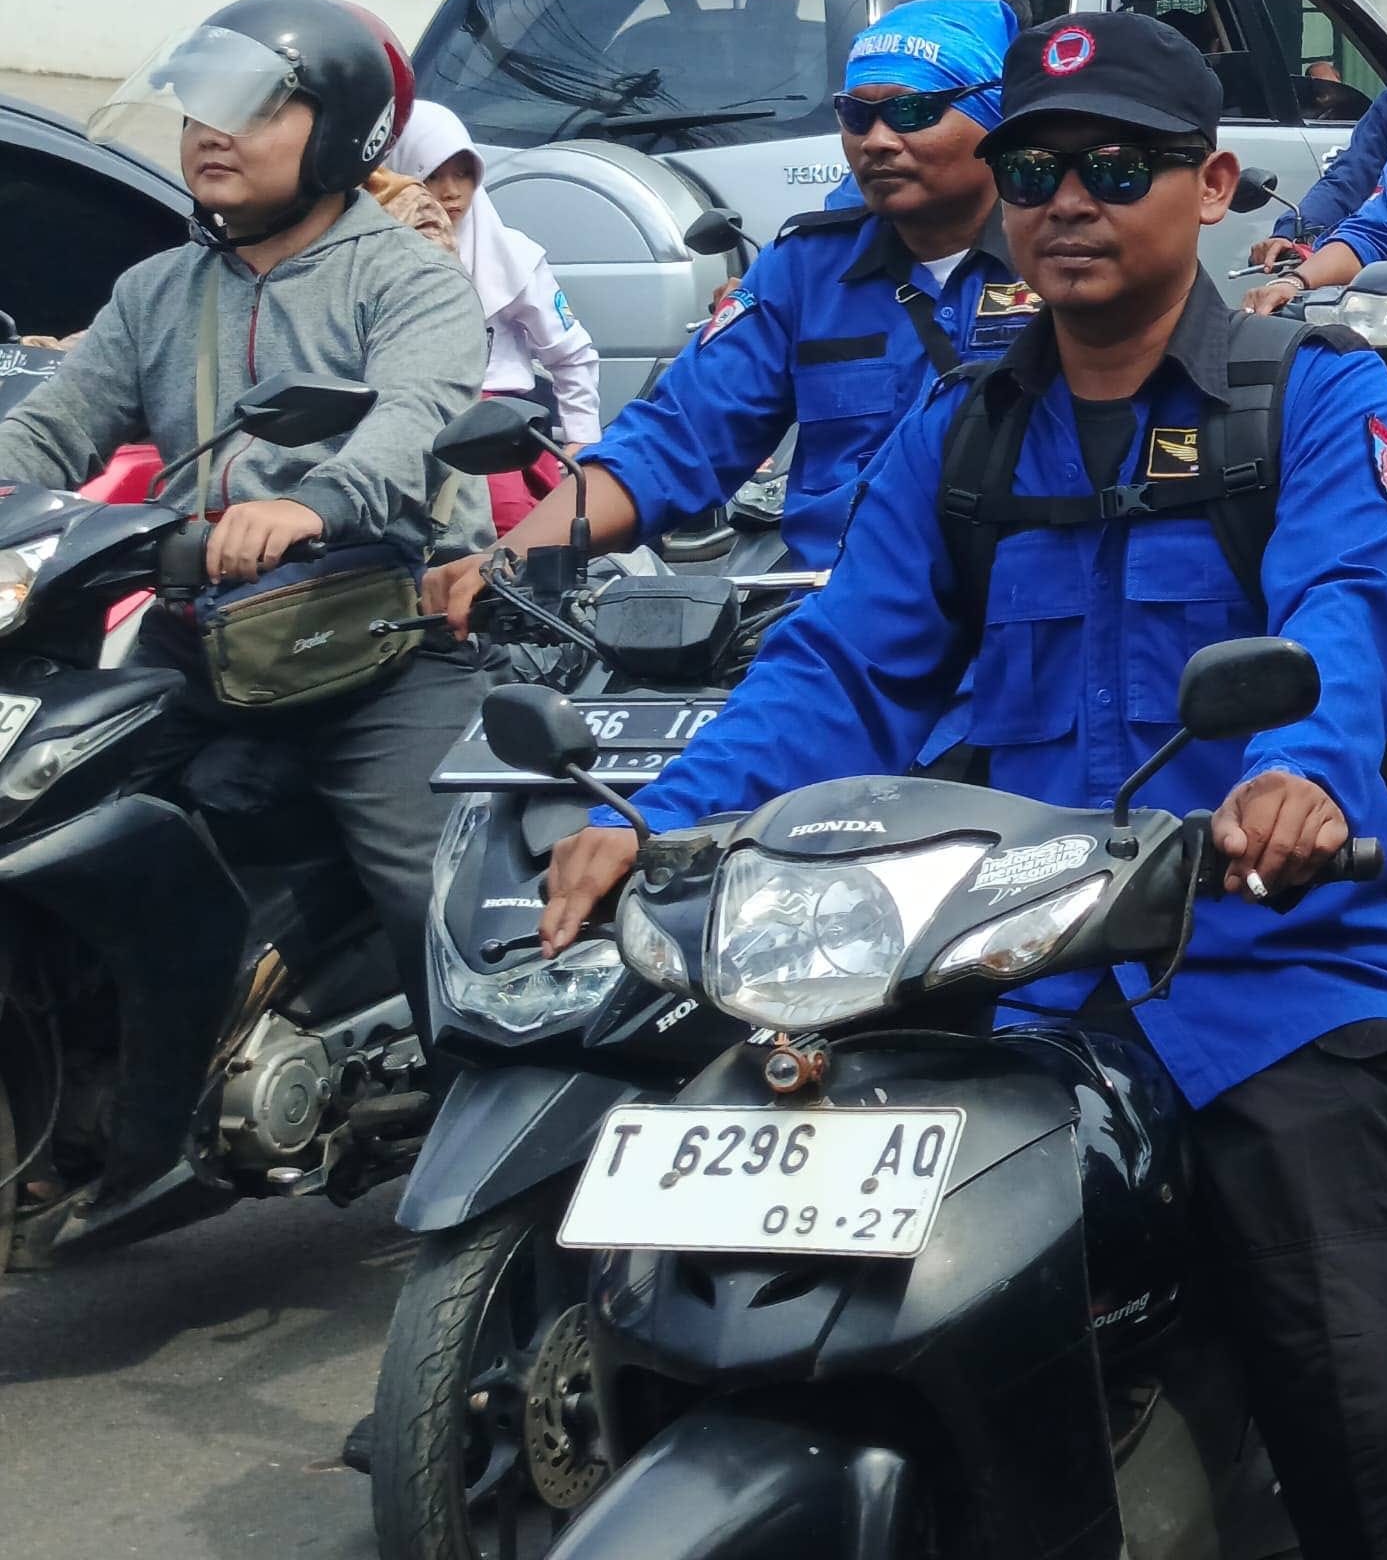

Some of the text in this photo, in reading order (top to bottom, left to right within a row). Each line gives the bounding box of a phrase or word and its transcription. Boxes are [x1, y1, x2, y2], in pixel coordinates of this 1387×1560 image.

[903, 36, 941, 64] SPSI
[788, 819, 887, 838] HONDA
[606, 1123, 947, 1179] T 6296 AQ
[1092, 1291, 1151, 1329] ouring
